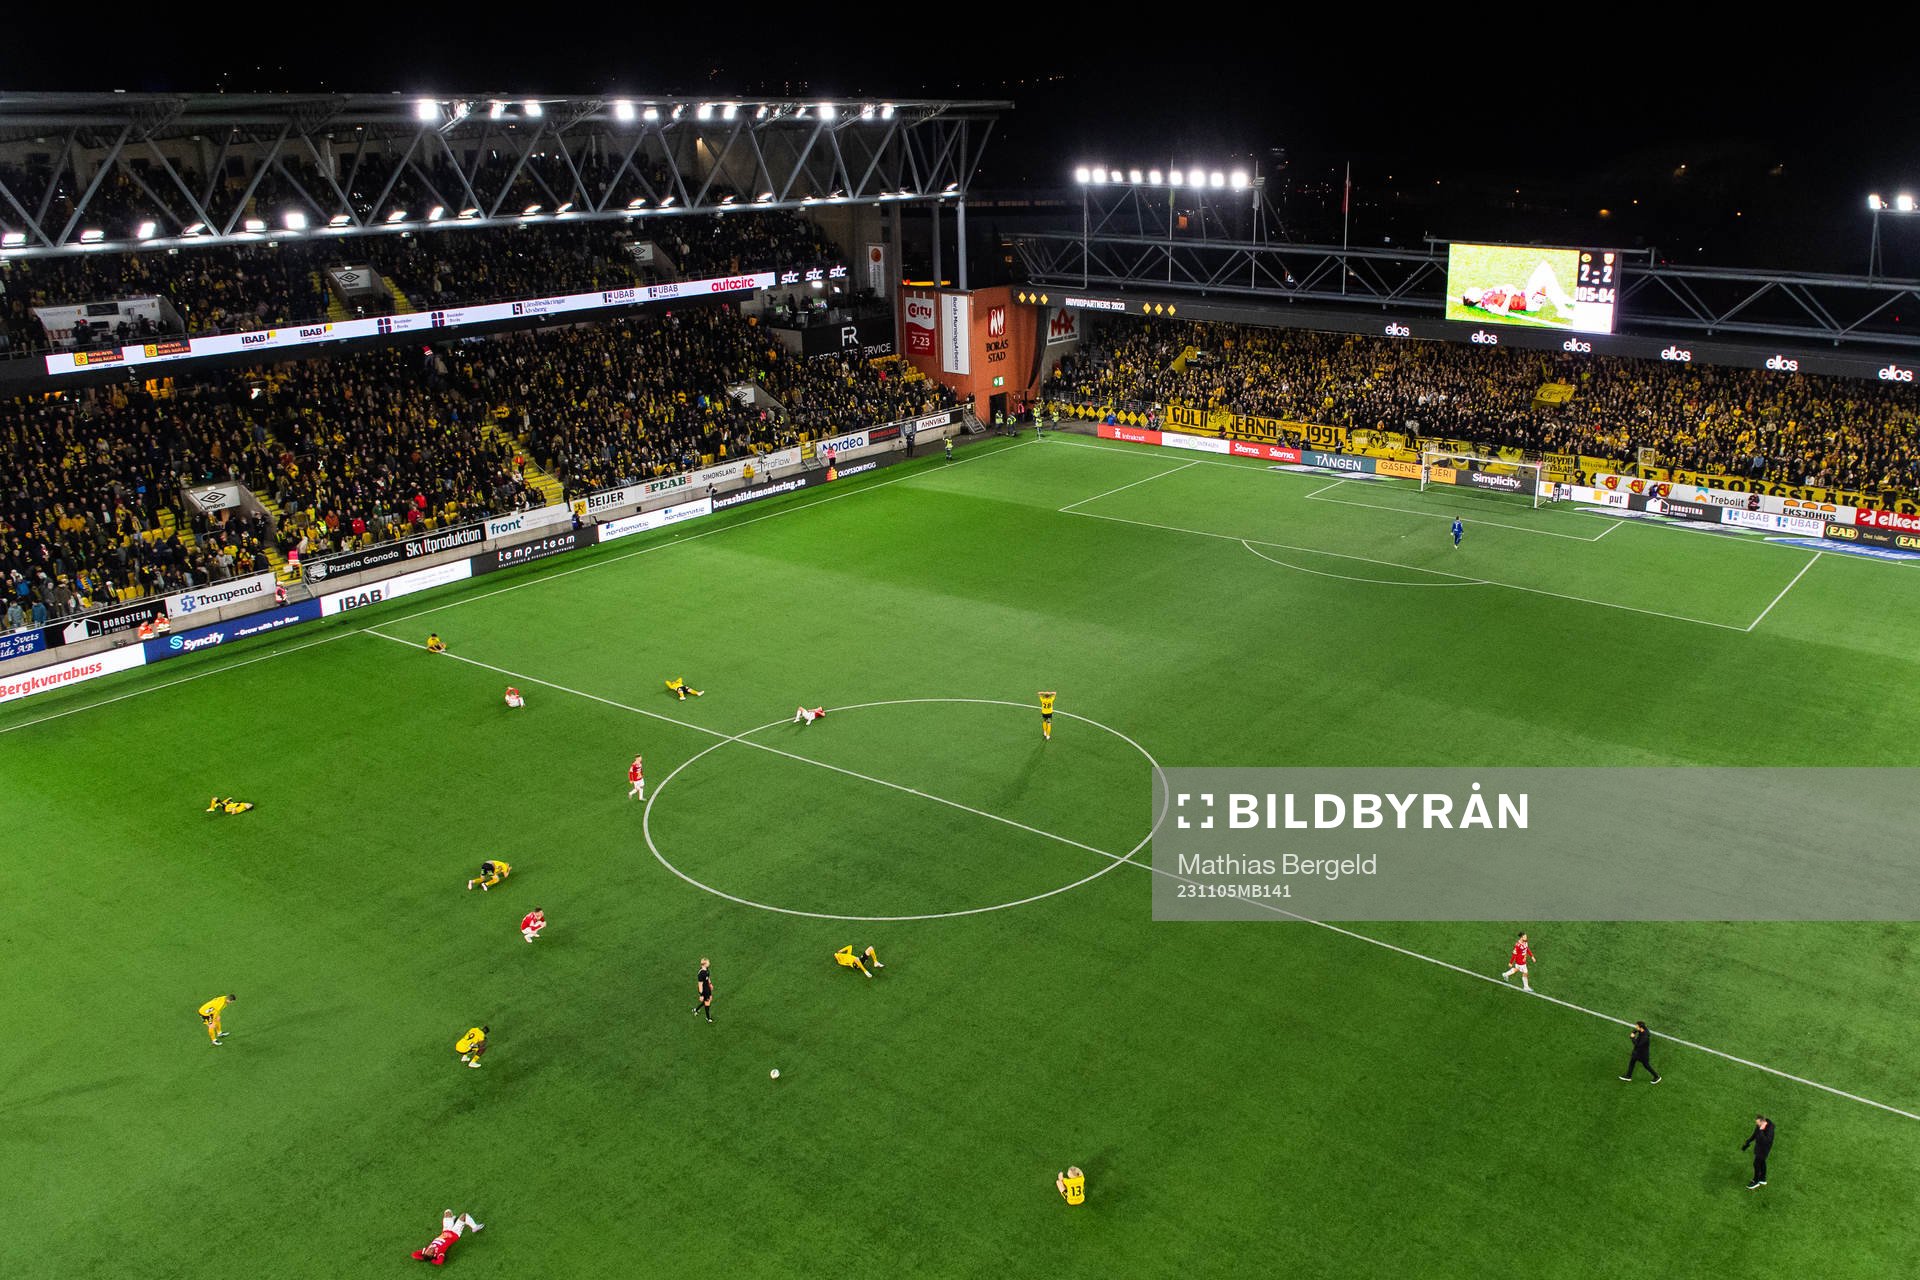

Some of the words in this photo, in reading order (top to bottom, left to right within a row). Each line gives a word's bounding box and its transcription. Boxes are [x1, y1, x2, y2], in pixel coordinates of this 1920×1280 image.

[781, 271, 799, 284] stc
[805, 268, 823, 281] stc
[829, 265, 847, 278] stc
[1580, 264, 1590, 281] 2
[1603, 265, 1612, 282] 2
[658, 285, 678, 294] UBAB
[711, 277, 754, 291] autocirc
[613, 290, 634, 299] UBAB
[300, 328, 322, 337] IBAB
[841, 327, 859, 347] FR
[1385, 323, 1410, 337] ellos
[1471, 330, 1497, 345] ellos
[241, 334, 265, 344] IBAB
[912, 336, 930, 346] 7-23
[1563, 338, 1591, 352] ellos
[1661, 346, 1691, 361] ellos
[1766, 355, 1798, 371] ellos
[1878, 365, 1912, 382] ellos
[1306, 425, 1338, 444] 1991
[823, 436, 864, 452] Nordea
[1315, 454, 1361, 471] TÅNGEN
[702, 467, 737, 481] SIMONSLAND
[1472, 472, 1520, 489] Simplicity
[650, 476, 687, 493] PEAB
[588, 491, 624, 508] BEIJER
[1710, 495, 1745, 507] Trebolit
[1741, 511, 1770, 523] UBAB
[1790, 518, 1819, 530] UBAB
[1830, 526, 1855, 538] EAB
[328, 561, 361, 573] Pizzeria
[363, 551, 399, 565] Granada
[340, 588, 383, 611] IBAB
[103, 609, 152, 629] BORGSTENA
[273, 619, 284, 627] the
[13, 633, 39, 646] Svets
[184, 632, 224, 651] Syncify
[0, 662, 103, 697] Bergkvarabuss
[1071, 1186, 1081, 1196] 13
